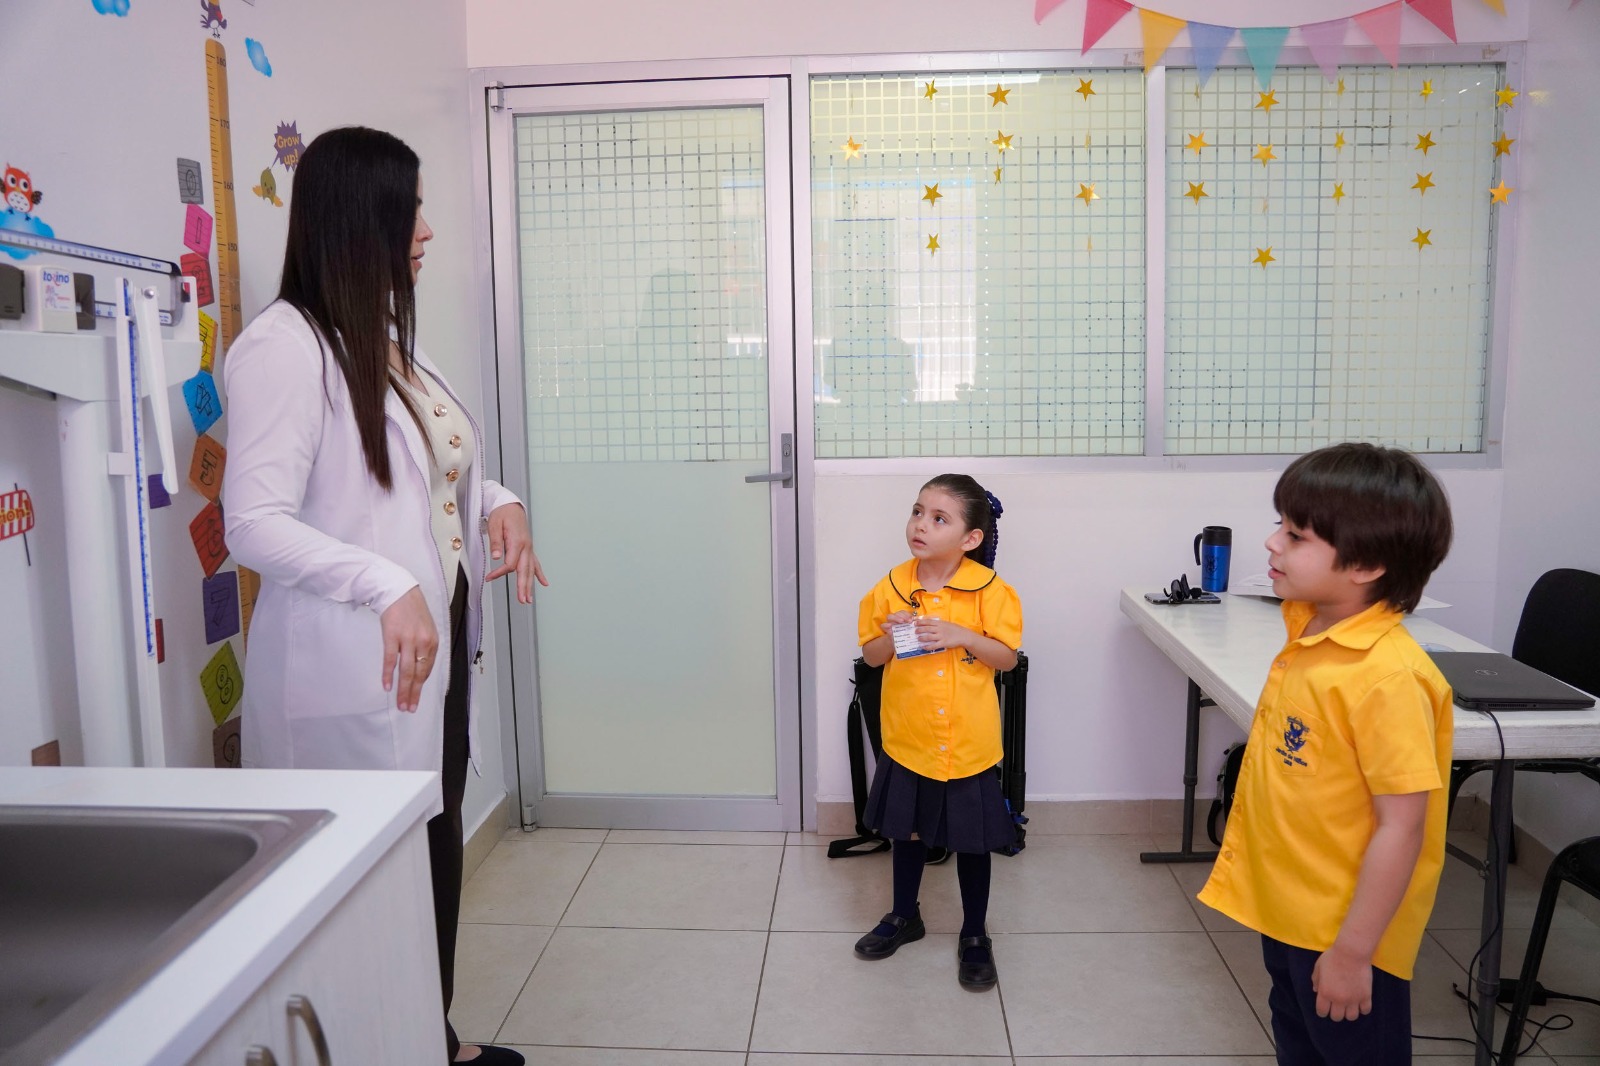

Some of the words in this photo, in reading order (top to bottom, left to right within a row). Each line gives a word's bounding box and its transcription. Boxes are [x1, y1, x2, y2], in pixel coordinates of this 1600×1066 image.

[217, 56, 226, 68] 180
[220, 118, 230, 129] 170
[277, 135, 300, 149] Grow
[283, 148, 299, 167] up!
[224, 181, 234, 192] 160
[227, 243, 238, 252] 150
[230, 303, 240, 312] 140
[200, 449, 218, 486] 5
[0, 500, 31, 524] ion!
[207, 518, 223, 558] 6
[211, 588, 230, 626] 7
[215, 664, 234, 705] 8
